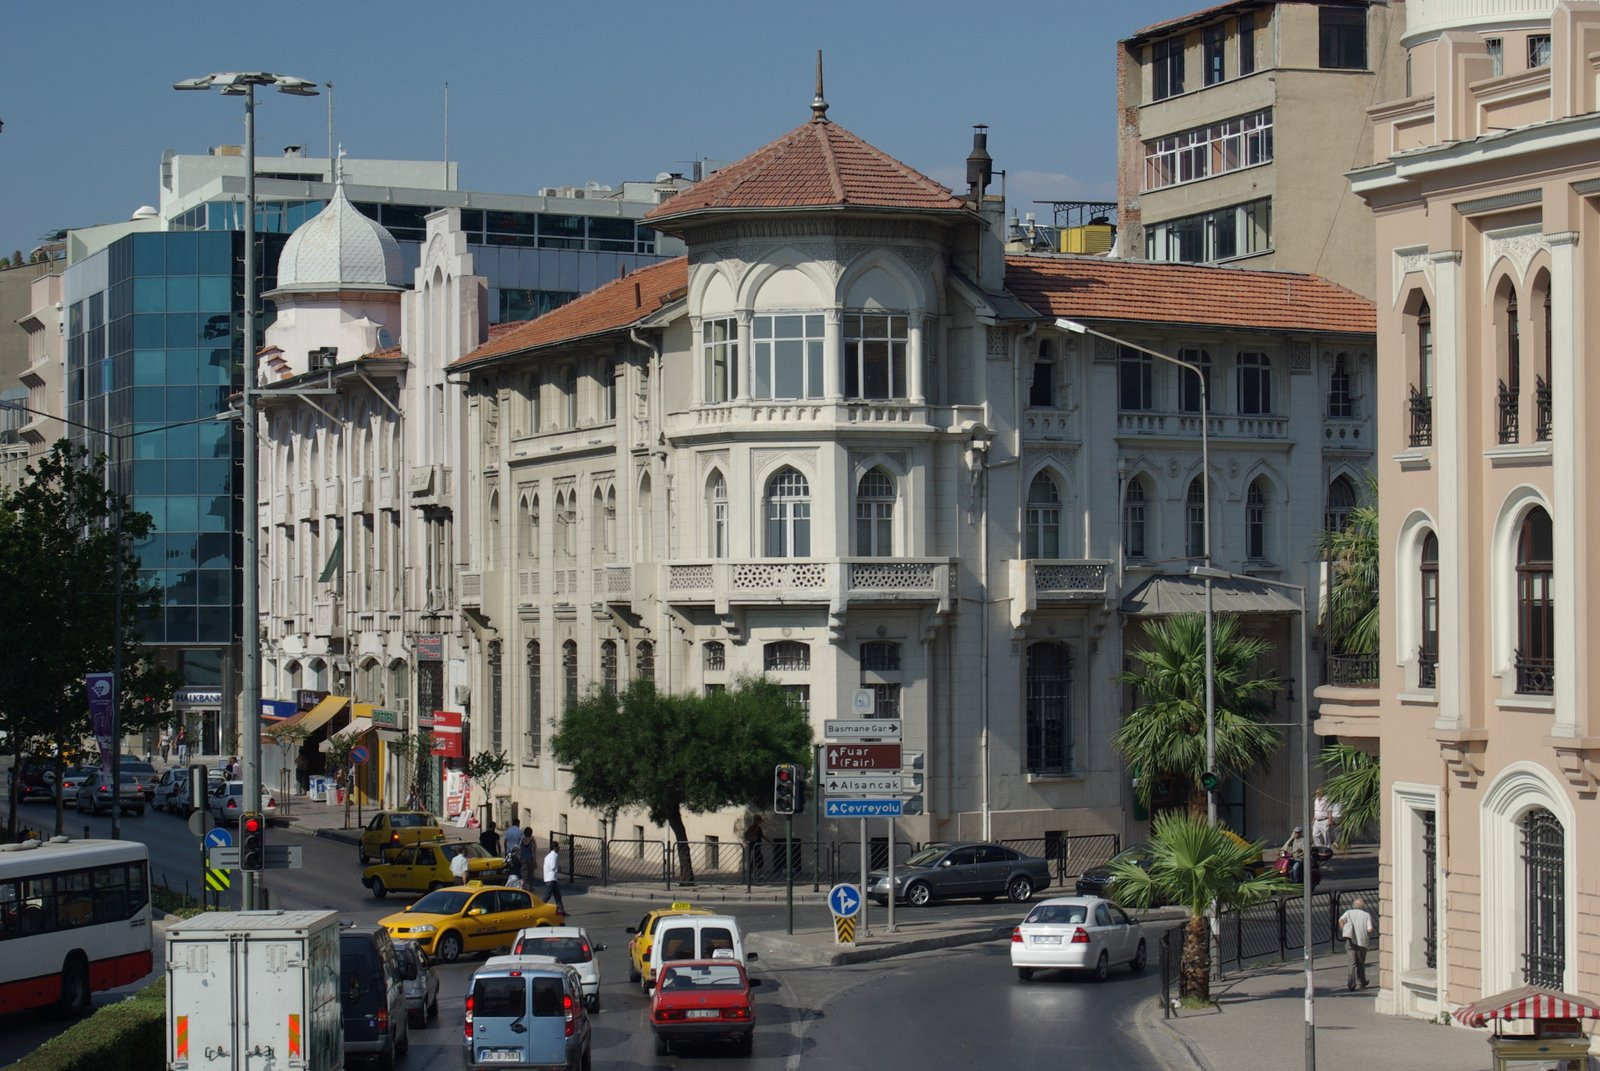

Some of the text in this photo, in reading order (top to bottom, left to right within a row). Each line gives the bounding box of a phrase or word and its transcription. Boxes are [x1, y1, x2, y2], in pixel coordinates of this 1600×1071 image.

[176, 693, 223, 702] HALKBANK
[840, 747, 869, 756] Fuar
[840, 758, 875, 767] (Fair)
[840, 781, 899, 790] Alsancak
[840, 803, 899, 814] Çevreyolu
